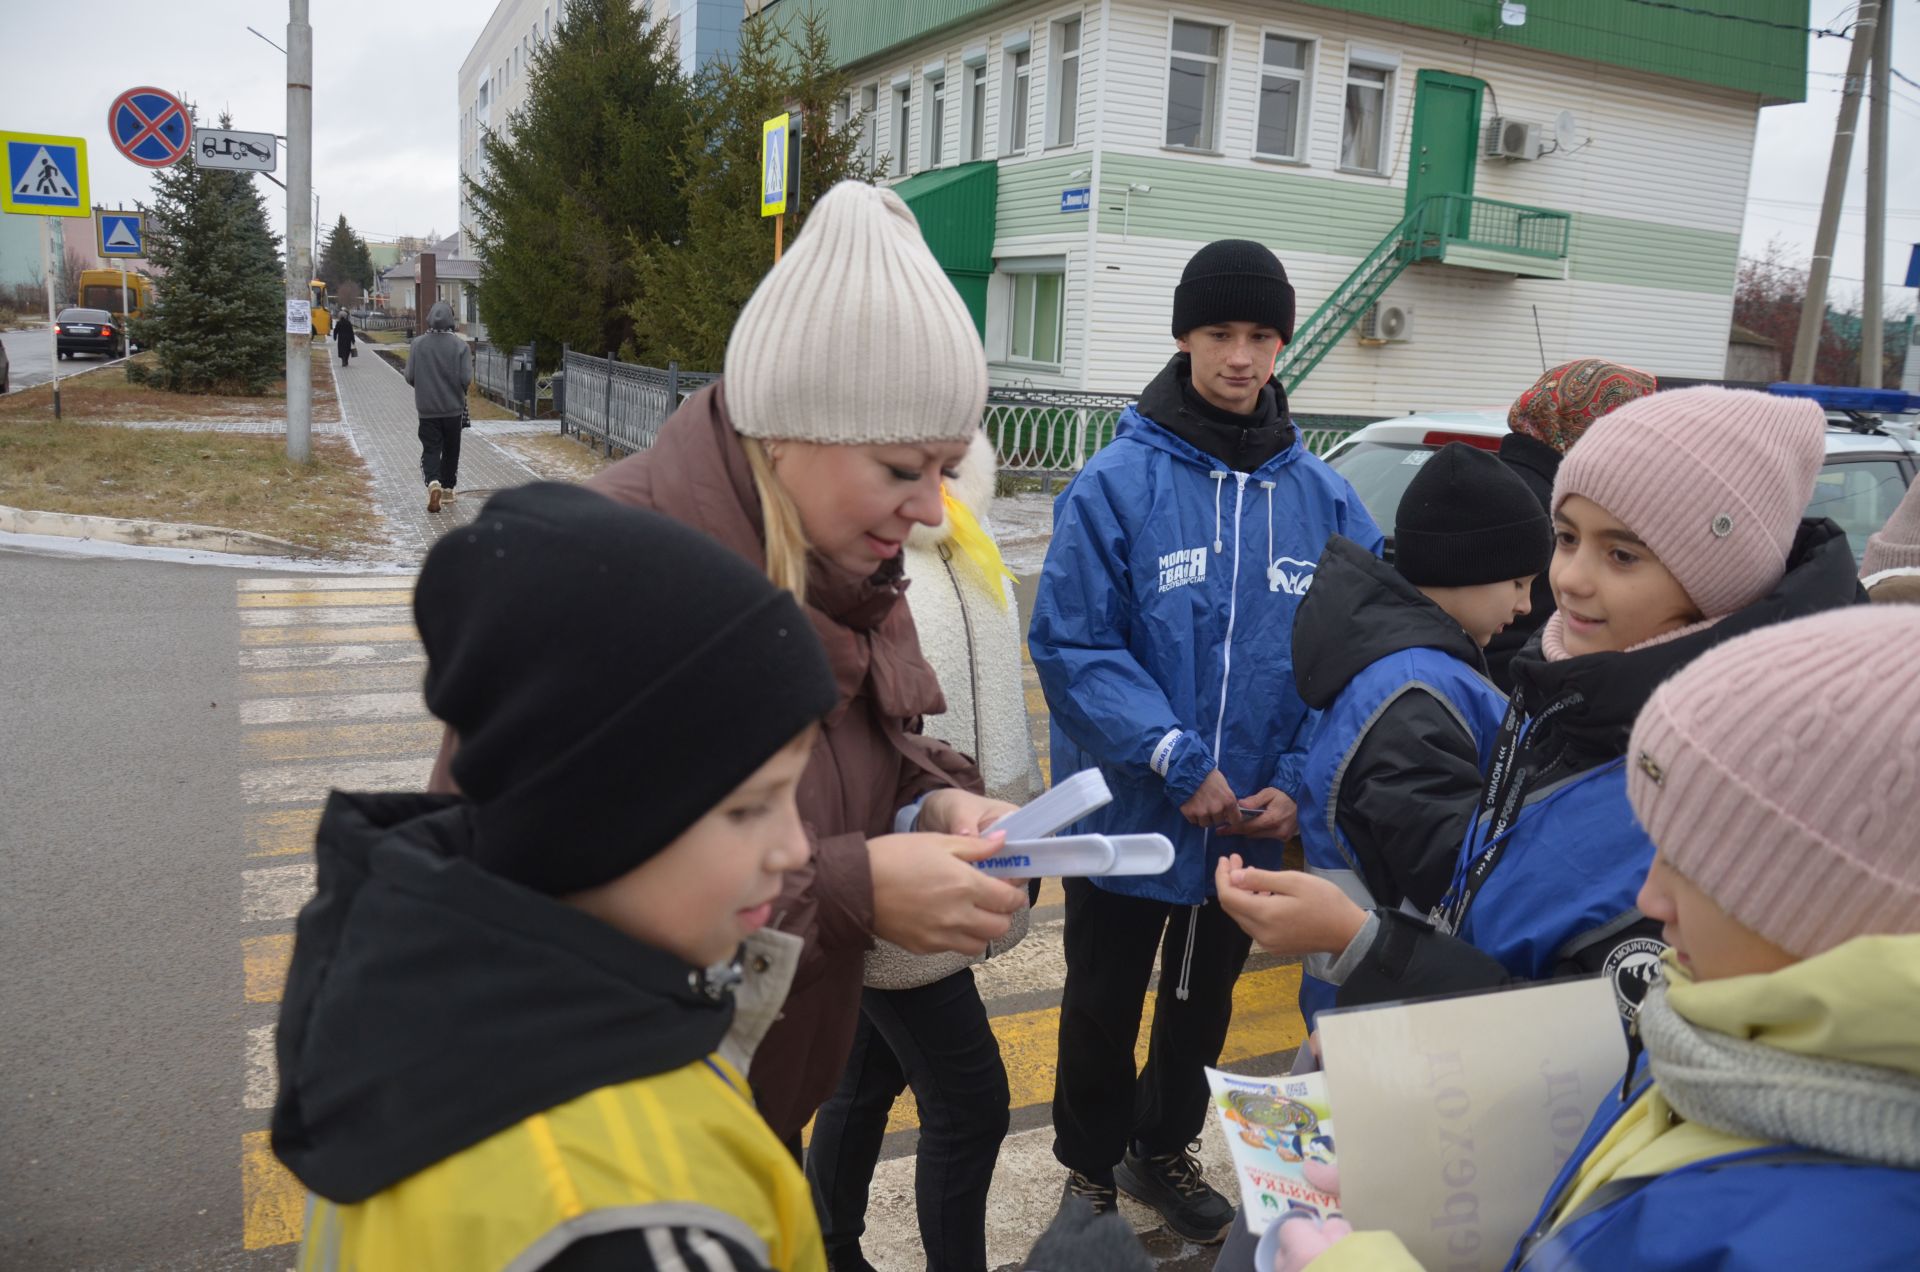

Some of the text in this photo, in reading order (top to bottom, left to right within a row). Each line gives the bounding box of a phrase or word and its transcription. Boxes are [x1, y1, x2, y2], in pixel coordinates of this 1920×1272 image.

[1486, 762, 1503, 804] MOVING
[1484, 819, 1507, 861] MOING
[977, 856, 1030, 869] ЕДИНАЯ
[1614, 942, 1661, 960] MOUNTAIN
